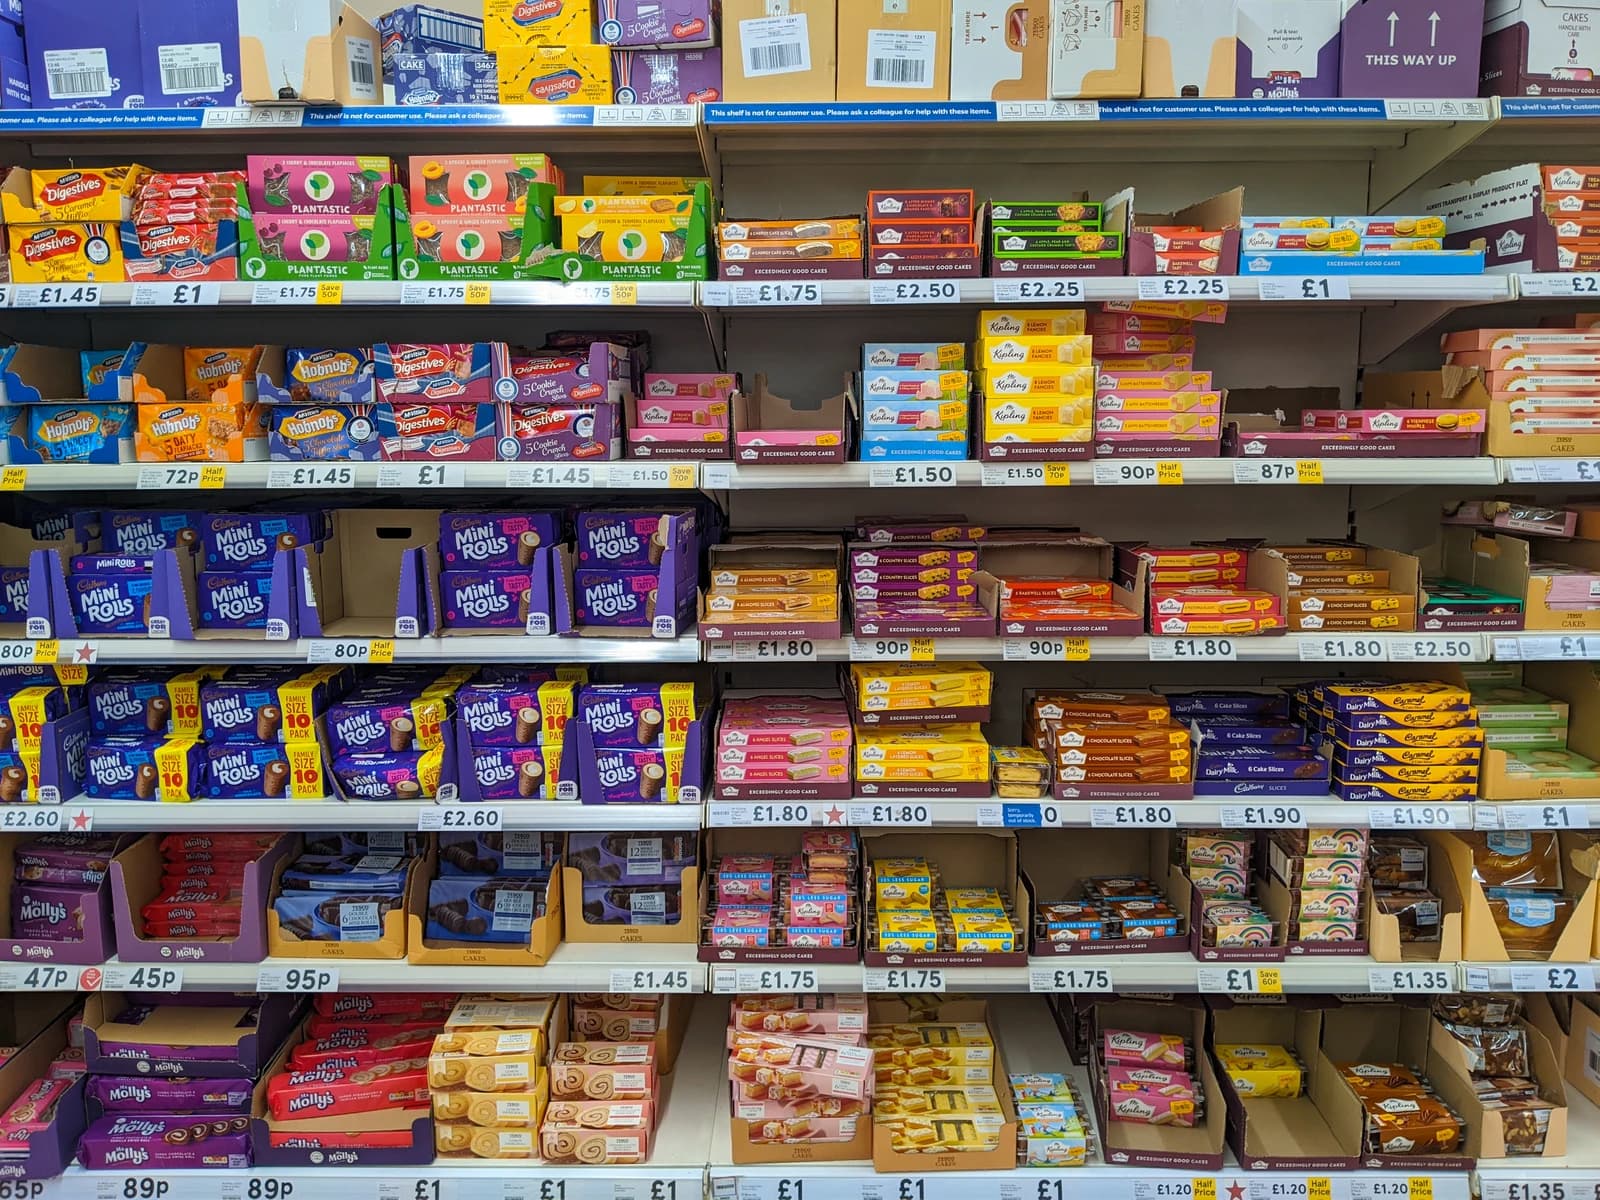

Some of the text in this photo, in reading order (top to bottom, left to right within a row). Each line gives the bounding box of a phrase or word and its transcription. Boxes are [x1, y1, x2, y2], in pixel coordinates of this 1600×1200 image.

[1562, 12, 1588, 22] CAKES
[400, 60, 424, 69] CAKE
[1365, 55, 1457, 66] THIS WAY UP
[869, 108, 903, 116] colleague
[915, 108, 931, 116] help
[1553, 176, 1581, 187] Kipling
[47, 177, 101, 203] Digestives
[1442, 194, 1467, 208] TRANSPORT
[1473, 188, 1491, 199] DISPLAY
[1491, 184, 1515, 195] PRODUCT
[1516, 179, 1529, 188] FLAT
[291, 204, 350, 215] PLANTASTIC
[141, 233, 191, 253] Digestives
[287, 265, 348, 275] PLANTASTIC
[39, 287, 97, 303] £1.45
[173, 284, 202, 304] £1
[279, 287, 316, 298] £1.75
[427, 287, 464, 298] £1.75
[758, 284, 818, 302] £1.75
[896, 283, 955, 298] £2.50
[1020, 281, 1080, 297] £2.25
[1164, 279, 1224, 295] £2.25
[1301, 278, 1330, 298] £1
[992, 348, 1025, 360] Kipling
[393, 356, 445, 375] Digestives
[45, 416, 94, 439] Hobnobs
[151, 414, 201, 436] Hobnobs
[1371, 417, 1401, 430] Kipling
[165, 469, 199, 486] 72p
[202, 474, 224, 482] Price
[206, 467, 223, 475] Half
[292, 468, 351, 484] £1.45
[418, 466, 446, 485] £1
[531, 468, 591, 484] £1.45
[632, 470, 668, 481] £1.50
[895, 467, 953, 482] £1.50
[1007, 467, 1043, 478] £1.50
[1120, 466, 1155, 481] 90p
[1261, 464, 1294, 479] 87p
[464, 537, 509, 560] ROLLS
[1, 645, 33, 658] 80p
[334, 644, 367, 658] 80p
[370, 649, 392, 657] Price
[757, 640, 814, 656] £1.80
[875, 641, 909, 655] 90p
[1029, 641, 1063, 655] 90p
[1174, 640, 1232, 656] £1.80
[1324, 641, 1382, 657] £1.80
[1414, 641, 1471, 657] £2.50
[1559, 637, 1587, 657] £1
[286, 702, 307, 713] SIZE
[285, 714, 311, 728] 10
[472, 711, 513, 733] ROLLS
[289, 729, 310, 738] PACK
[1205, 763, 1239, 777] Dairy Milk
[1234, 783, 1265, 794] Cadbury
[1398, 786, 1431, 796] Caramel
[4, 811, 59, 827] £2.60
[442, 811, 499, 826] £2.60
[753, 805, 808, 822] £1.80
[872, 806, 927, 822] £1.80
[1116, 806, 1172, 823] £1.80
[1244, 807, 1301, 823] £1.90
[1393, 808, 1450, 824] £1.90
[1542, 807, 1570, 827] £1
[20, 902, 67, 924] Molly's
[23, 968, 68, 988] 47p
[129, 968, 176, 988] 45p
[285, 969, 331, 990] 95p
[633, 971, 688, 988] £1.45
[760, 971, 815, 989] £1.75
[887, 970, 942, 988] £1.75
[1054, 970, 1109, 988] £1.75
[1227, 969, 1253, 991] £1
[1259, 971, 1278, 979] Save
[1262, 978, 1277, 986] 60p
[1393, 971, 1448, 989] £1.35
[1548, 968, 1579, 989] £2
[1110, 1035, 1144, 1049] Kipling
[109, 1087, 152, 1101] Molly's
[0, 1180, 44, 1199] 65p
[123, 1178, 169, 1198] 89p
[247, 1178, 293, 1199] 89p
[415, 1179, 441, 1200] £1
[540, 1179, 566, 1200] £1
[651, 1179, 677, 1200] £1
[778, 1179, 804, 1200] £1
[899, 1178, 925, 1200] £1
[1037, 1179, 1063, 1200] £1
[1157, 1184, 1192, 1195] £1.20
[1197, 1180, 1214, 1188] Half
[1272, 1183, 1307, 1195] £1.20
[1373, 1183, 1408, 1195] £1.20
[1508, 1183, 1565, 1200] £1.35
[1194, 1188, 1216, 1197] Price
